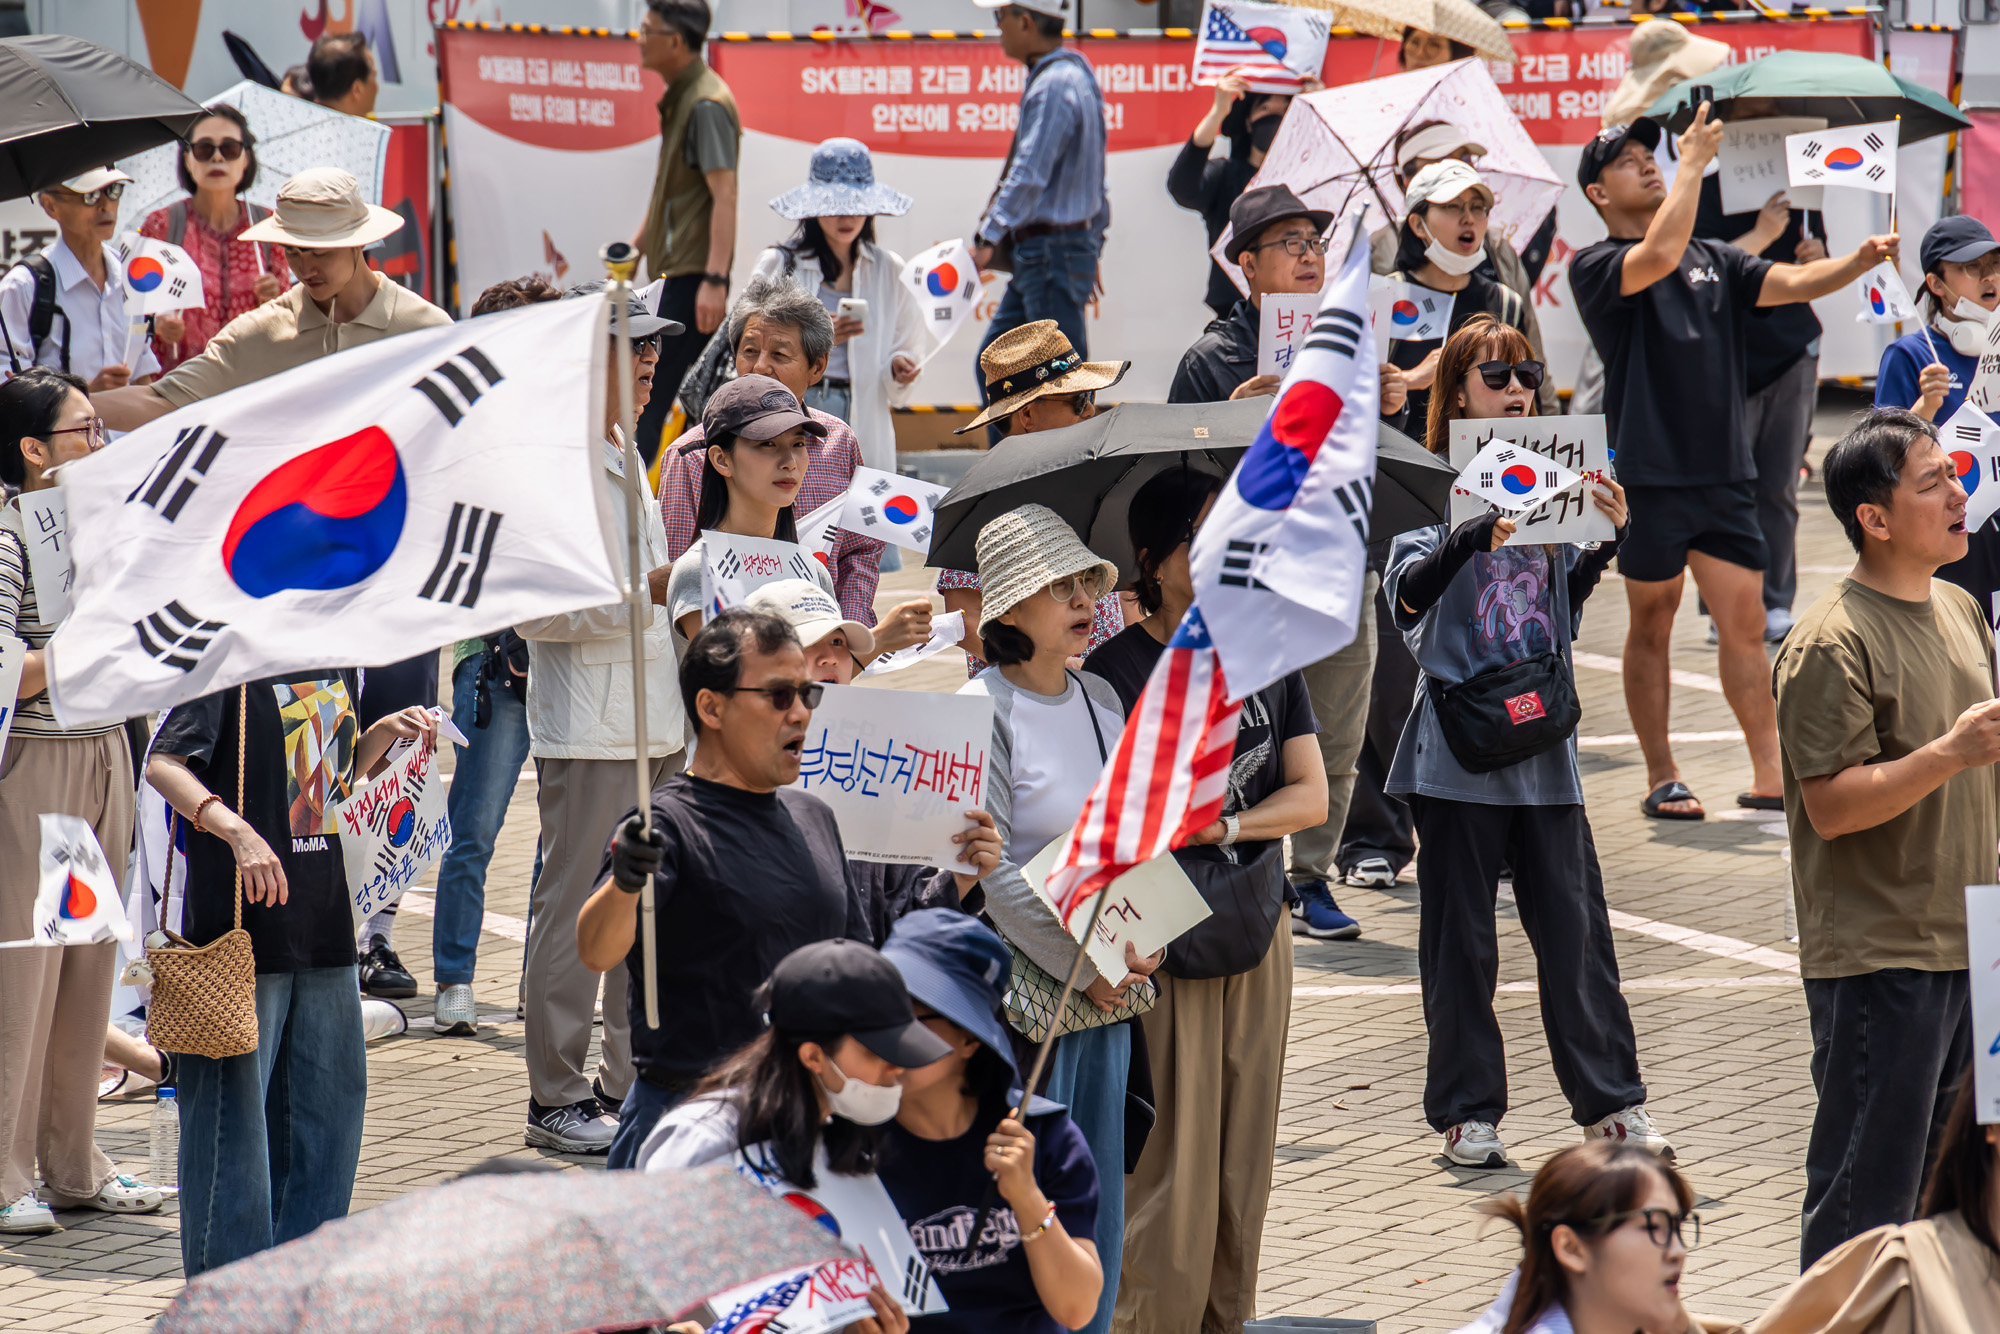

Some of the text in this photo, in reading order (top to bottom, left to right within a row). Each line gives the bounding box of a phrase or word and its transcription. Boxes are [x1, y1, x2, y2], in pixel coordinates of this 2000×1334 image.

[801, 65, 913, 95] SK텔레콤
[920, 65, 971, 95] 긴급
[977, 64, 1027, 95] 서비
[1521, 54, 1570, 82] 긴급
[1577, 53, 1628, 80] 서비
[872, 103, 949, 132] 안전에
[1505, 90, 1614, 120] 전에 유의
[741, 552, 784, 578] 부정선거
[343, 771, 401, 837] 부정선거
[292, 836, 329, 853] MoMA
